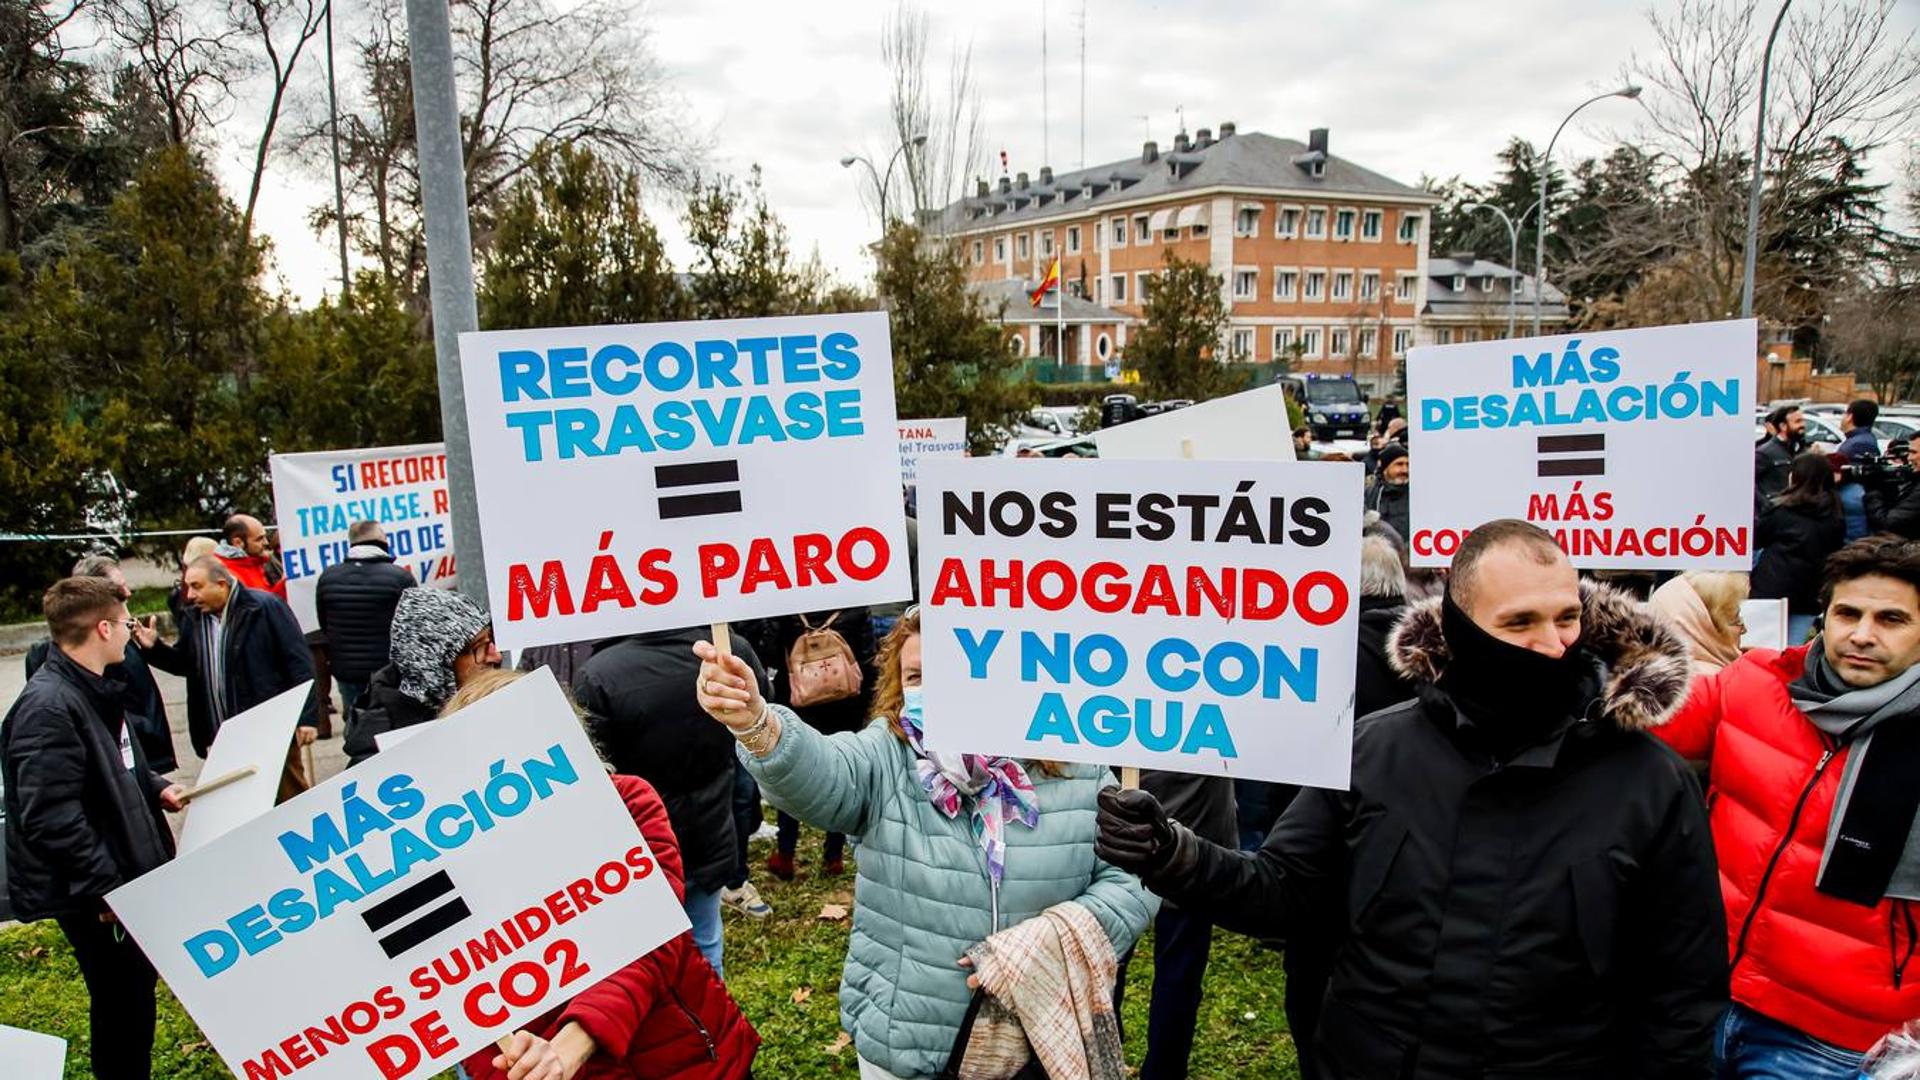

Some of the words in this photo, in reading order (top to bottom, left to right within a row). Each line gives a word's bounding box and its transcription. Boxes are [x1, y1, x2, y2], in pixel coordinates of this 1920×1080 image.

[499, 332, 862, 402] RECORTES
[1512, 340, 1621, 388] MÁS
[506, 389, 865, 461] TRASVASE
[1421, 371, 1740, 431] DESALACIÓN
[332, 464, 356, 493] SI
[1527, 481, 1614, 521] MÁS
[942, 491, 1077, 538] NOS
[1096, 481, 1331, 546] ESTÁIS
[1413, 515, 1747, 557] COINACIÓN
[283, 548, 316, 580] EL
[417, 524, 446, 552] DE
[508, 531, 678, 621] MÁS
[698, 527, 890, 598] PARO
[930, 558, 1349, 626] AHOGANDO
[953, 628, 1004, 679] Y
[1021, 631, 1128, 687] NO
[1146, 638, 1318, 702] CON
[1025, 693, 1238, 758] AGUA
[278, 773, 425, 874] MÁS
[183, 744, 579, 978] DESALACIÓN
[242, 986, 405, 1080] MENOS
[410, 847, 654, 1000] SUMIDEROS
[366, 1010, 460, 1080] DE
[463, 938, 591, 1029] CO2
